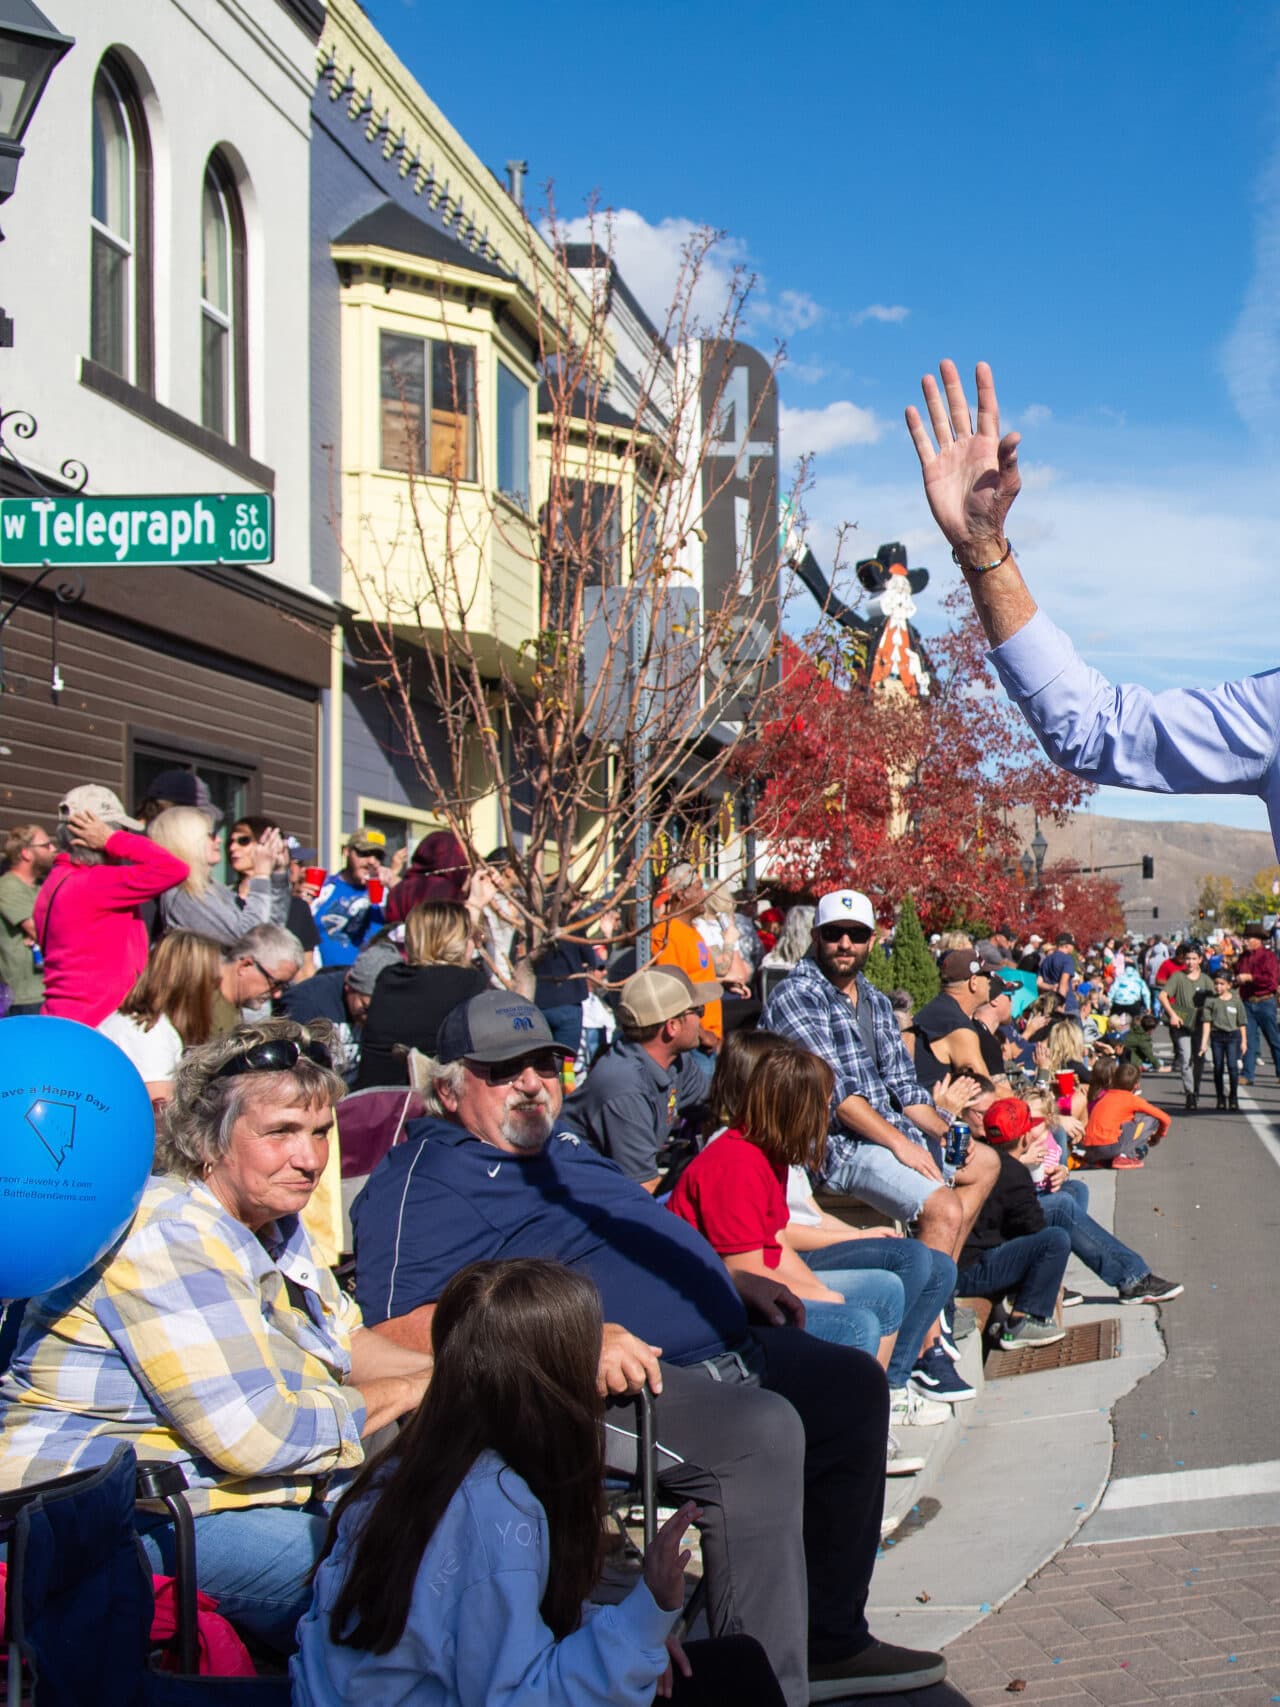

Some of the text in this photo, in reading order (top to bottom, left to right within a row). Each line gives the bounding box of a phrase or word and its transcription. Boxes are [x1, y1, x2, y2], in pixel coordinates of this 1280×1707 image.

[32, 501, 215, 560] Telegraph
[235, 503, 258, 526] St
[229, 528, 266, 551] 100
[1, 1088, 25, 1099] ave
[42, 1084, 82, 1100] Happy
[86, 1094, 110, 1112] Day!
